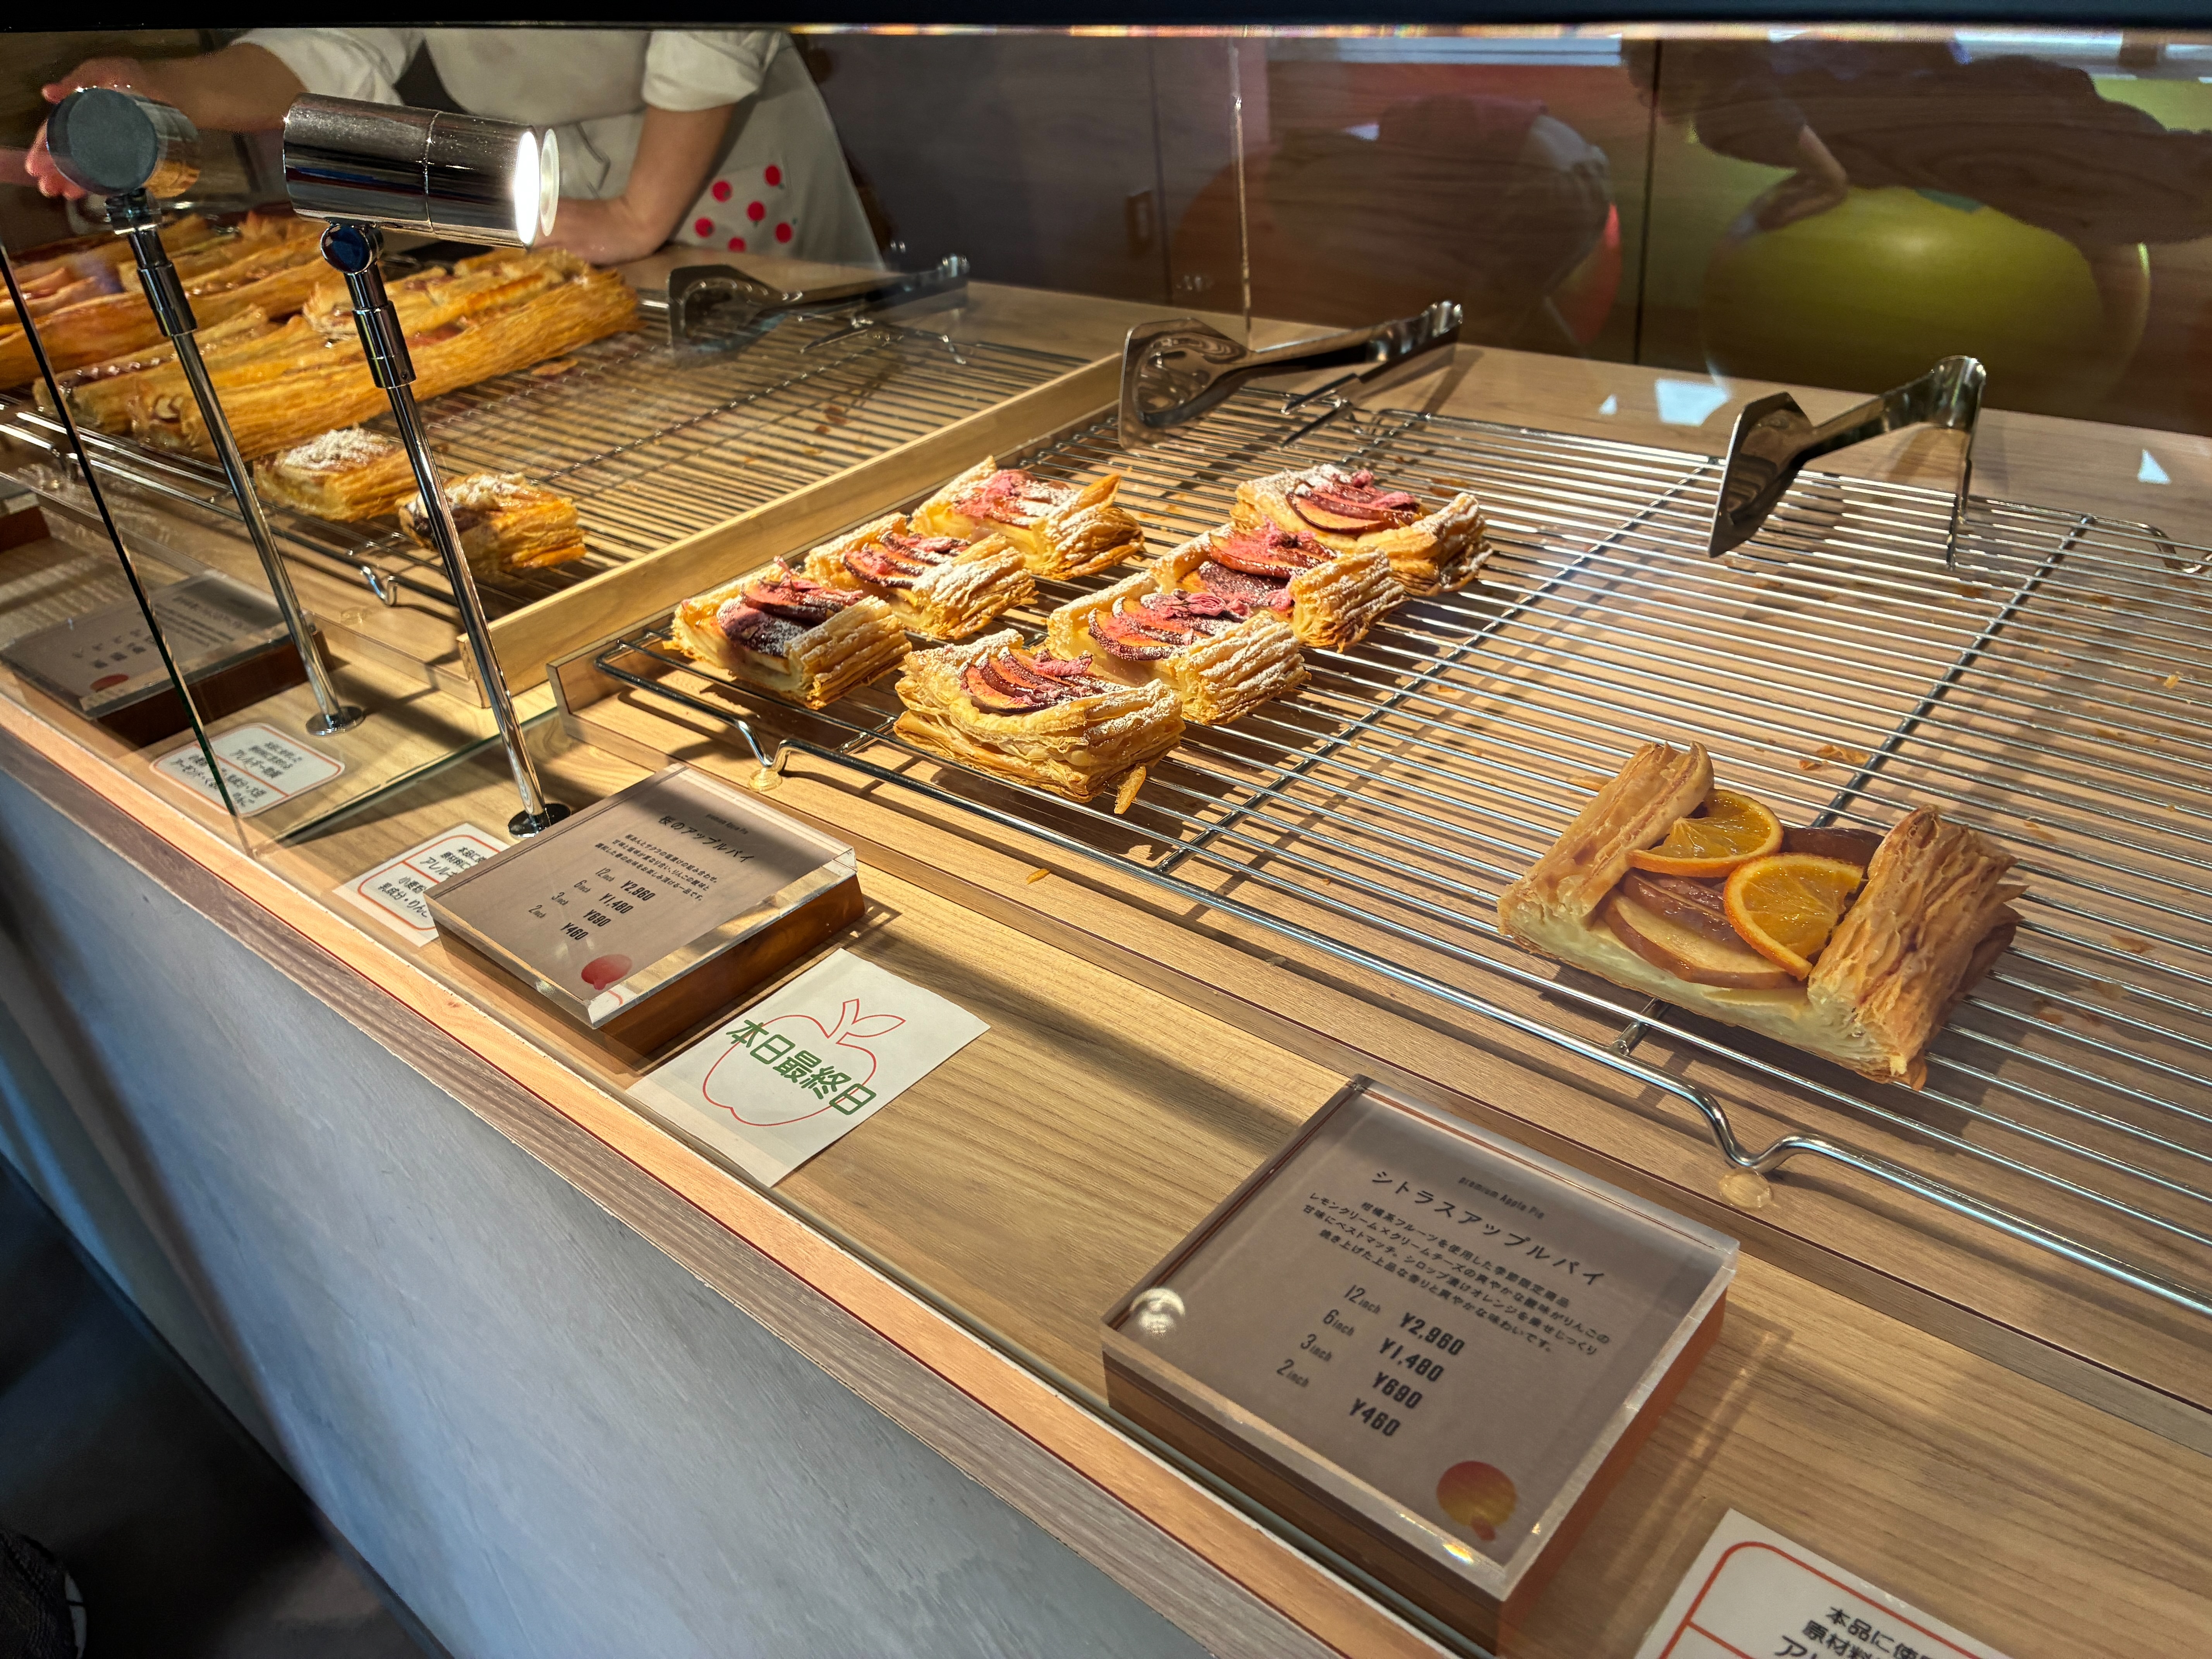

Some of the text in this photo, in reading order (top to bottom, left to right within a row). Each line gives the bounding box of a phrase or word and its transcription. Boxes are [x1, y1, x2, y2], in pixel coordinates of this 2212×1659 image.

[378, 882, 428, 917] 乳成分・りん
[599, 893, 634, 914] ¥1,480
[620, 880, 656, 901] ¥2,960
[560, 922, 589, 940] ¥460
[583, 909, 611, 927] ¥690
[726, 1019, 877, 1115] 本日最終日
[1500, 1195, 1526, 1211] Apple
[1528, 1207, 1545, 1219] Pie
[1372, 1171, 1605, 1285] シトラスアップルパイ
[1323, 1309, 1354, 1336] 6inch
[1344, 1285, 1465, 1355] 12inch ¥2,960
[1300, 1334, 1332, 1362] 3inch
[1276, 1359, 1401, 1436] 2inch ¥460
